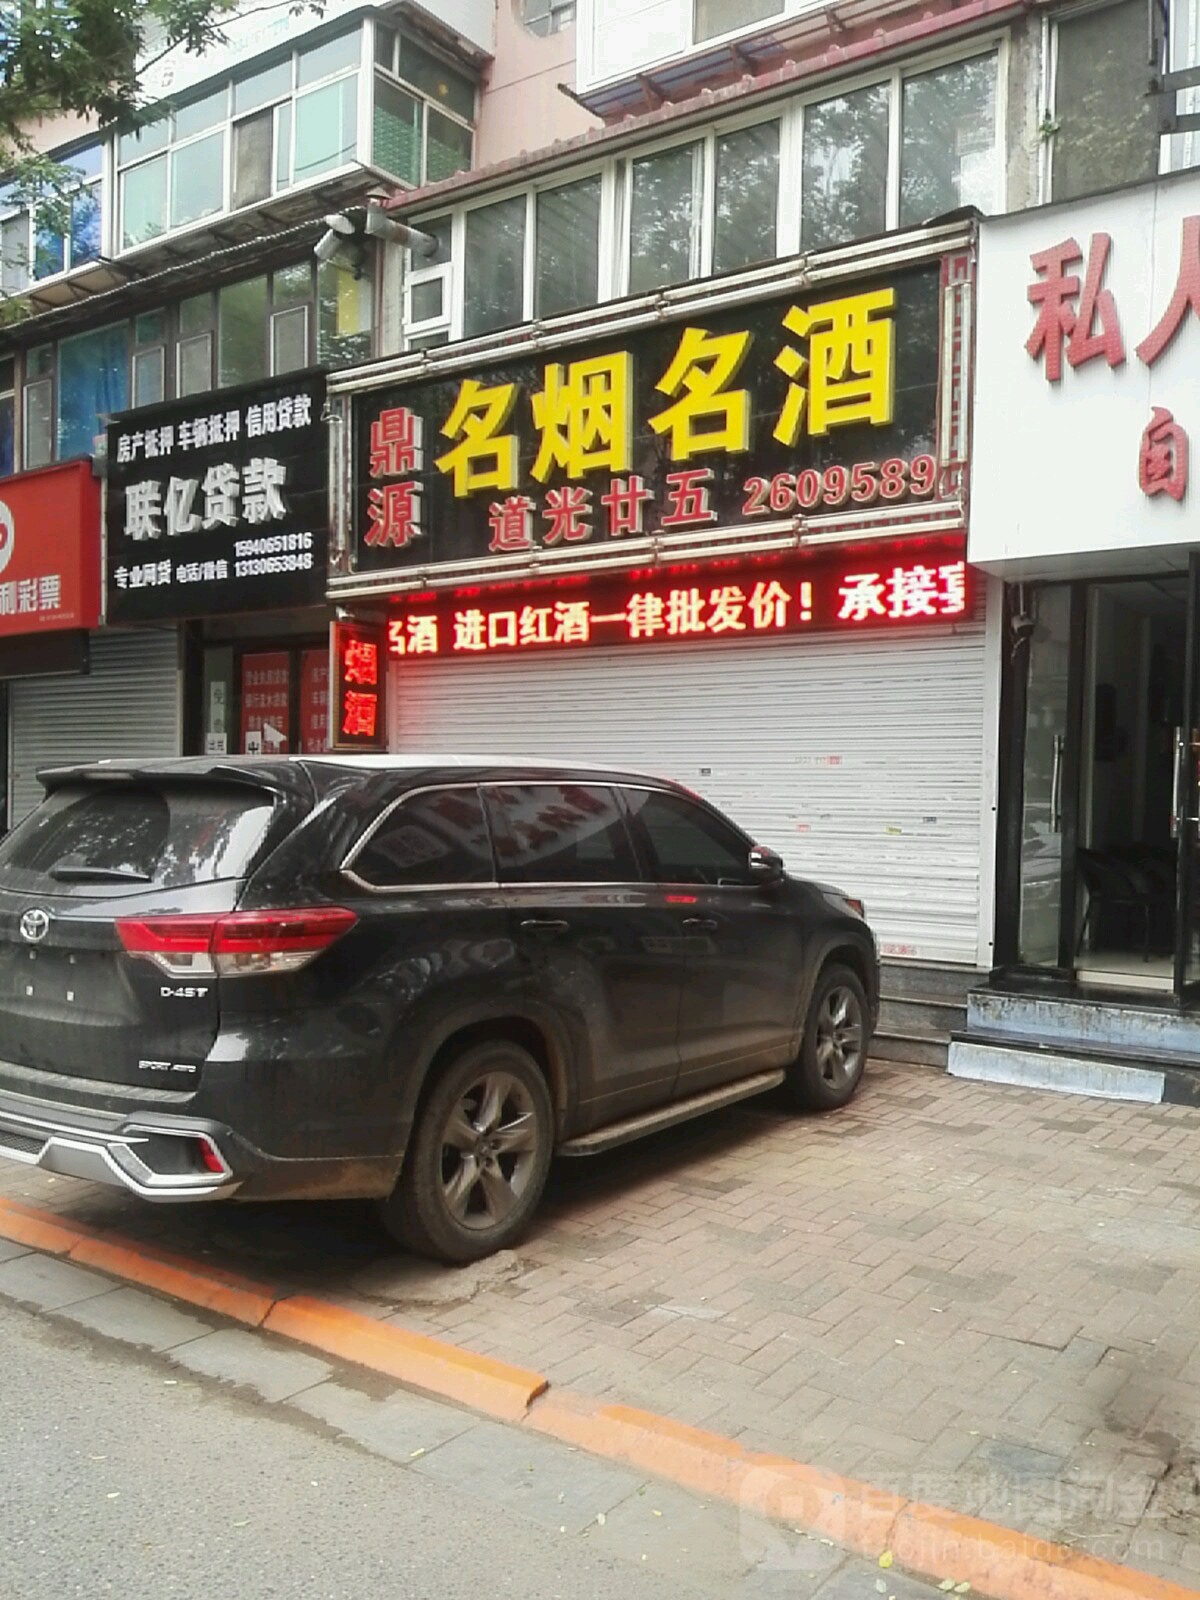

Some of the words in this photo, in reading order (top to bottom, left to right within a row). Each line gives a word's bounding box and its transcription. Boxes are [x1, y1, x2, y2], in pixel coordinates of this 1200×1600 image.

[116, 425, 175, 463] 房产抵押
[177, 410, 240, 450] 车辆抵押
[244, 393, 312, 437] 信用贷款
[434, 288, 896, 498] 名烟名酒
[124, 457, 287, 541] 联亿贷款
[364, 406, 424, 547] 鼎源
[488, 467, 718, 552] 道光廿五
[742, 454, 938, 516] 2609589
[114, 559, 172, 589] 专业网贷
[234, 532, 313, 557] 15940651816
